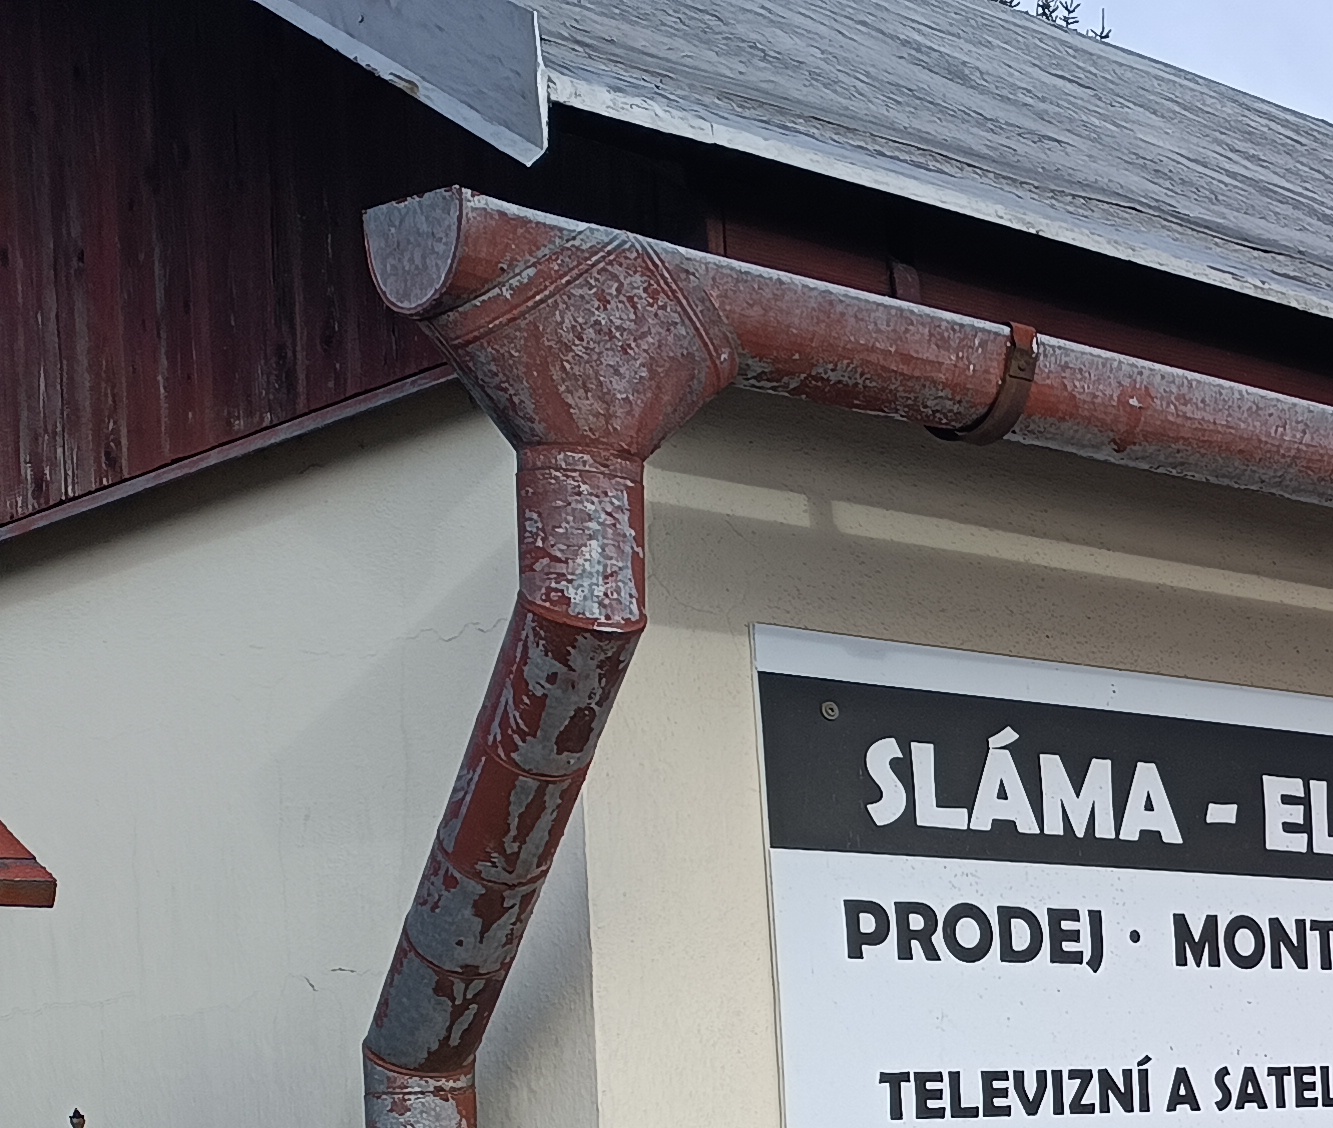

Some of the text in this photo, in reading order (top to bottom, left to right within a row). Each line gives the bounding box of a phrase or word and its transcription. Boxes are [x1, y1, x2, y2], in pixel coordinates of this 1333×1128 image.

[865, 725, 1184, 844] SLÁMA
[843, 899, 1104, 974] PRODEJ
[879, 1055, 1152, 1121] TELEVIZNÍ
[1166, 1066, 1202, 1113] A
